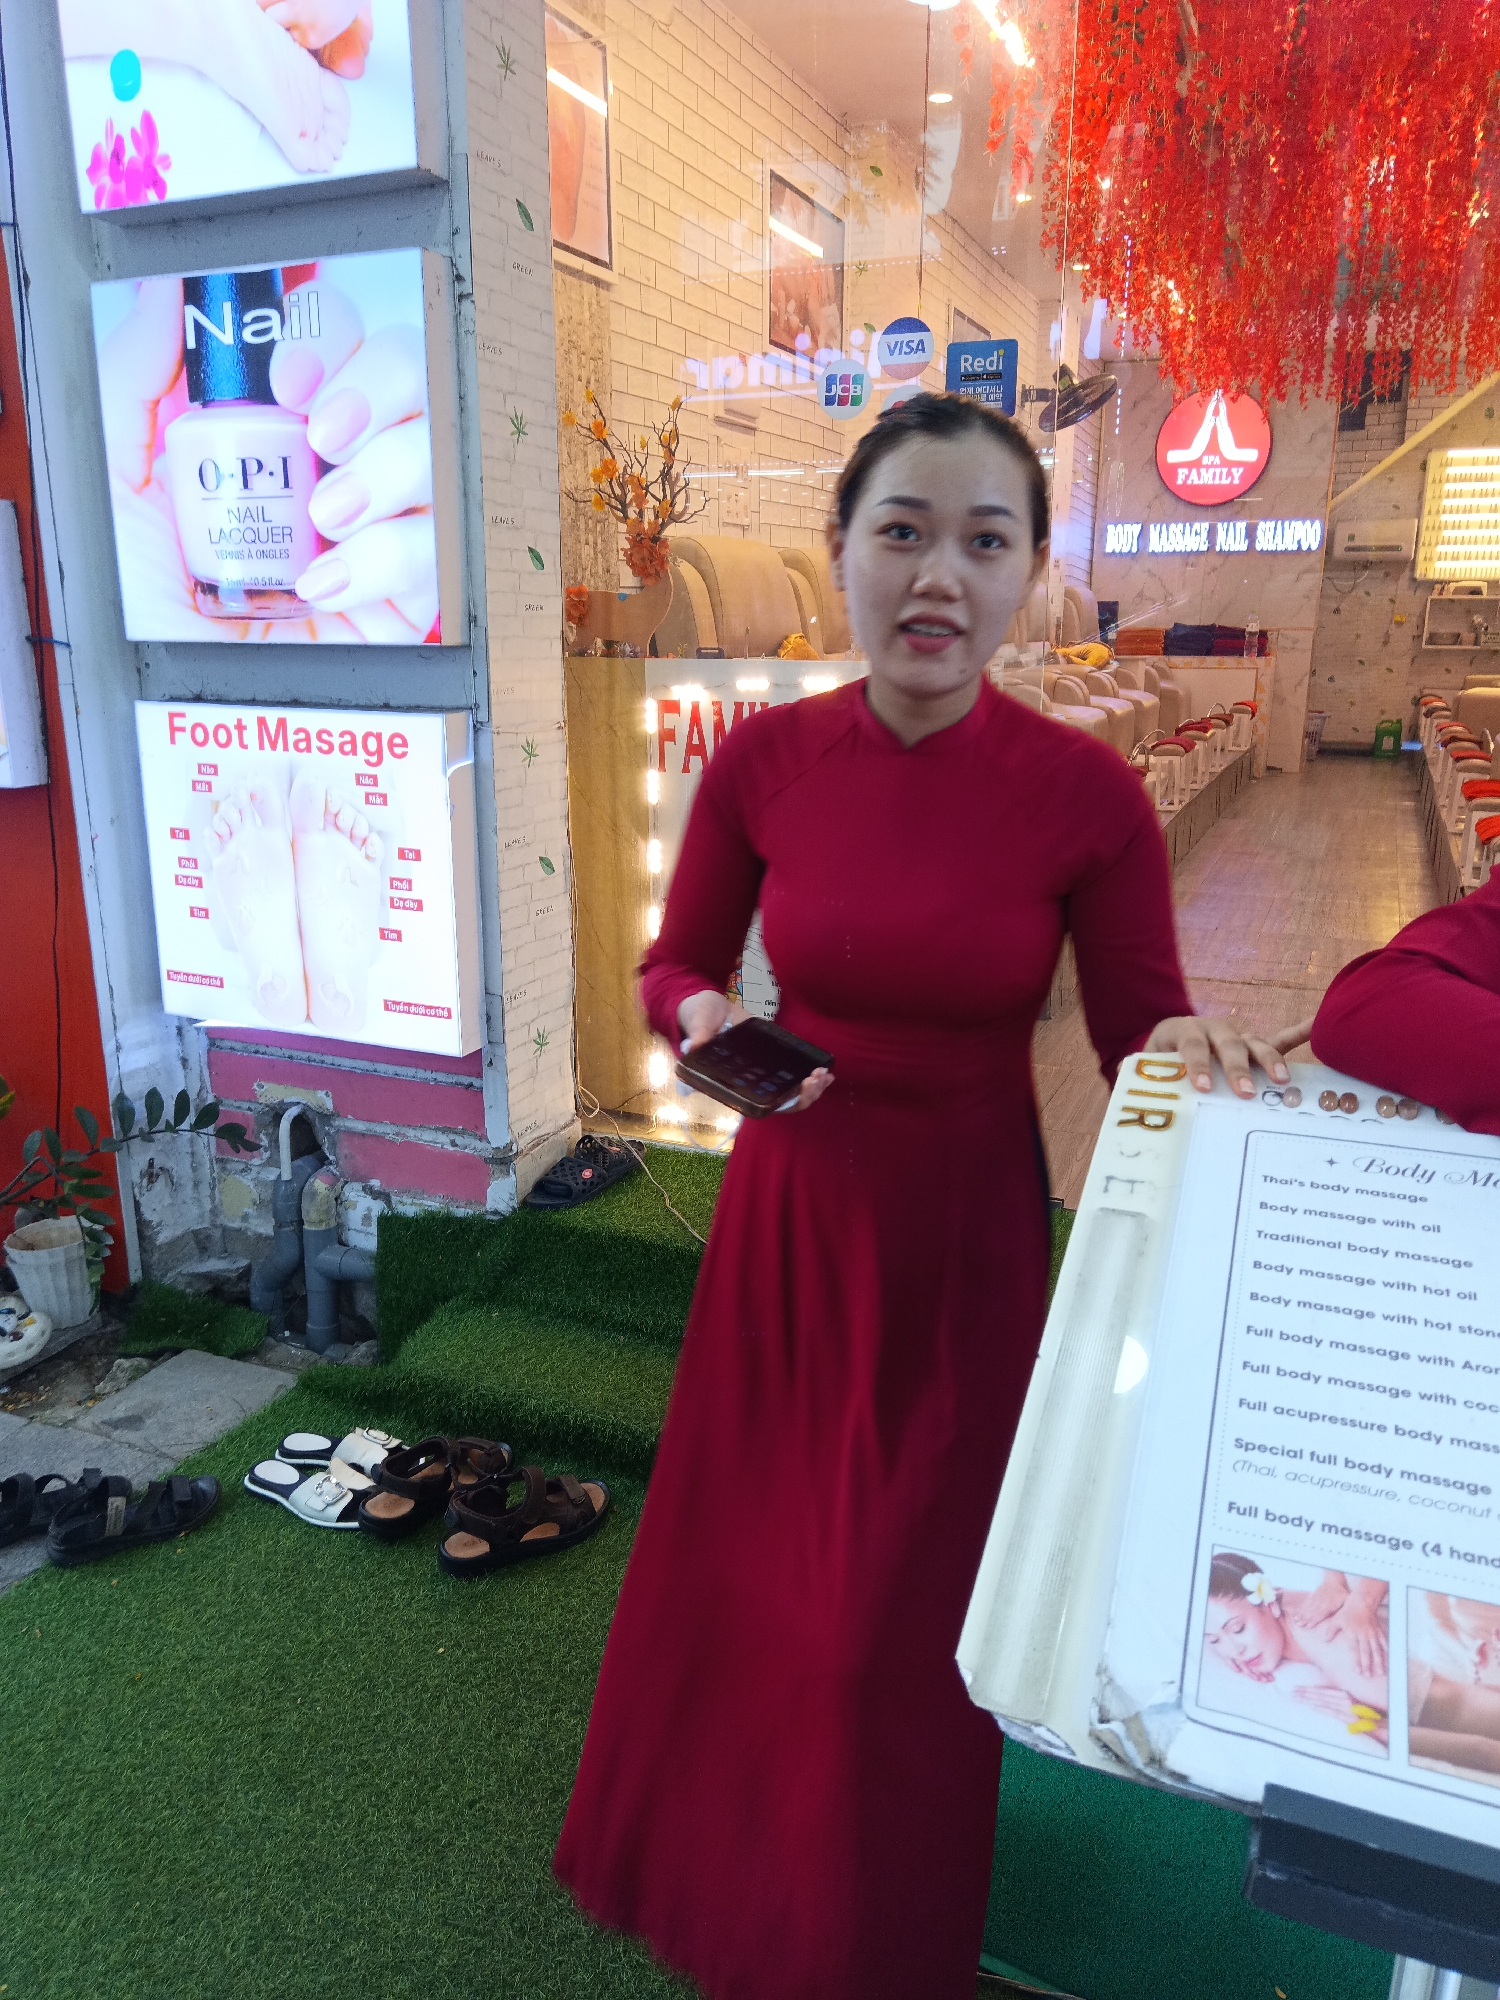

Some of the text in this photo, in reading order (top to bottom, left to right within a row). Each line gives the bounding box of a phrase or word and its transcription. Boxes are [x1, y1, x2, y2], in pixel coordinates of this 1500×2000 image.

[184, 291, 321, 349] Nail
[886, 338, 926, 357] VISA
[960, 348, 1005, 373] Redi
[1176, 468, 1244, 485] FAMILY
[1201, 455, 1220, 465] SPA
[227, 506, 273, 524] NAIL
[208, 526, 293, 545] LACQUER
[1106, 520, 1323, 553] BODY MASSAGE NAIL SHAMPOO
[255, 548, 290, 560] ONGLES
[168, 711, 409, 767] Foot Masage
[1353, 1156, 1436, 1185] Body
[1310, 1181, 1350, 1194] body
[1355, 1187, 1428, 1203] massage
[1259, 1201, 1441, 1233] Body massage with oil
[1256, 1230, 1474, 1268] Traditional body massage
[1253, 1260, 1477, 1301] Body massage with hot oil
[1250, 1292, 1291, 1307] Body
[1297, 1299, 1376, 1319] massage
[1382, 1311, 1418, 1326] with
[1424, 1318, 1452, 1331] hot
[1246, 1325, 1273, 1338] Full
[1279, 1330, 1323, 1347] body
[1329, 1339, 1411, 1361] massage
[1417, 1352, 1455, 1368] with
[1242, 1361, 1270, 1375] Full
[1276, 1366, 1322, 1384] body
[1327, 1376, 1412, 1399] massage
[1418, 1390, 1457, 1406] with
[1238, 1398, 1267, 1412] Full
[1273, 1405, 1388, 1433] acupressure
[1394, 1424, 1443, 1445] body
[1234, 1438, 1492, 1496] Special full body massage
[1232, 1459, 1278, 1479] (Thai,
[1285, 1470, 1401, 1502] acupressure,
[1408, 1495, 1492, 1519] coconut
[1227, 1501, 1258, 1518] Full
[1264, 1509, 1315, 1532] body
[1321, 1522, 1414, 1551] massage
[1421, 1541, 1443, 1557] (4
